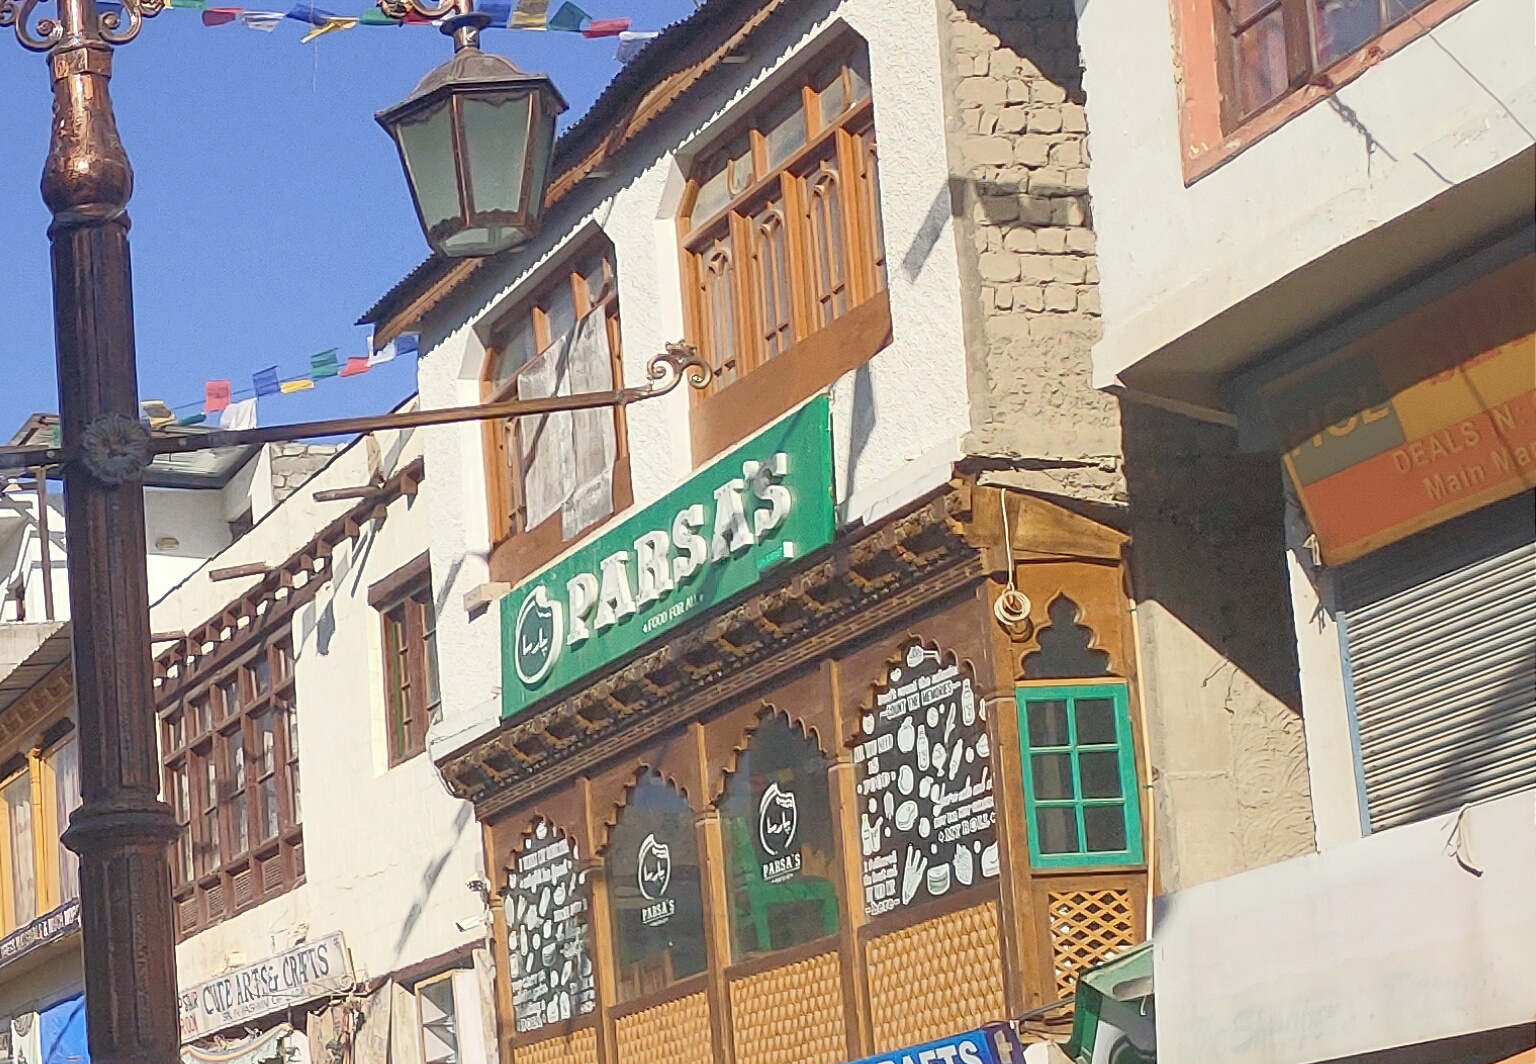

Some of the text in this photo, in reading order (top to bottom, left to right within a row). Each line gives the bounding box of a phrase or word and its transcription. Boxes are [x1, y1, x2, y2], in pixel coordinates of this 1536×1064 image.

[1392, 421, 1481, 475] DEALS
[1422, 462, 1486, 501] Main
[565, 451, 794, 648] PARSA'S
[762, 853, 801, 879] PARSA'S
[641, 899, 675, 922] PARSA'S
[282, 944, 330, 988] CRAFTS
